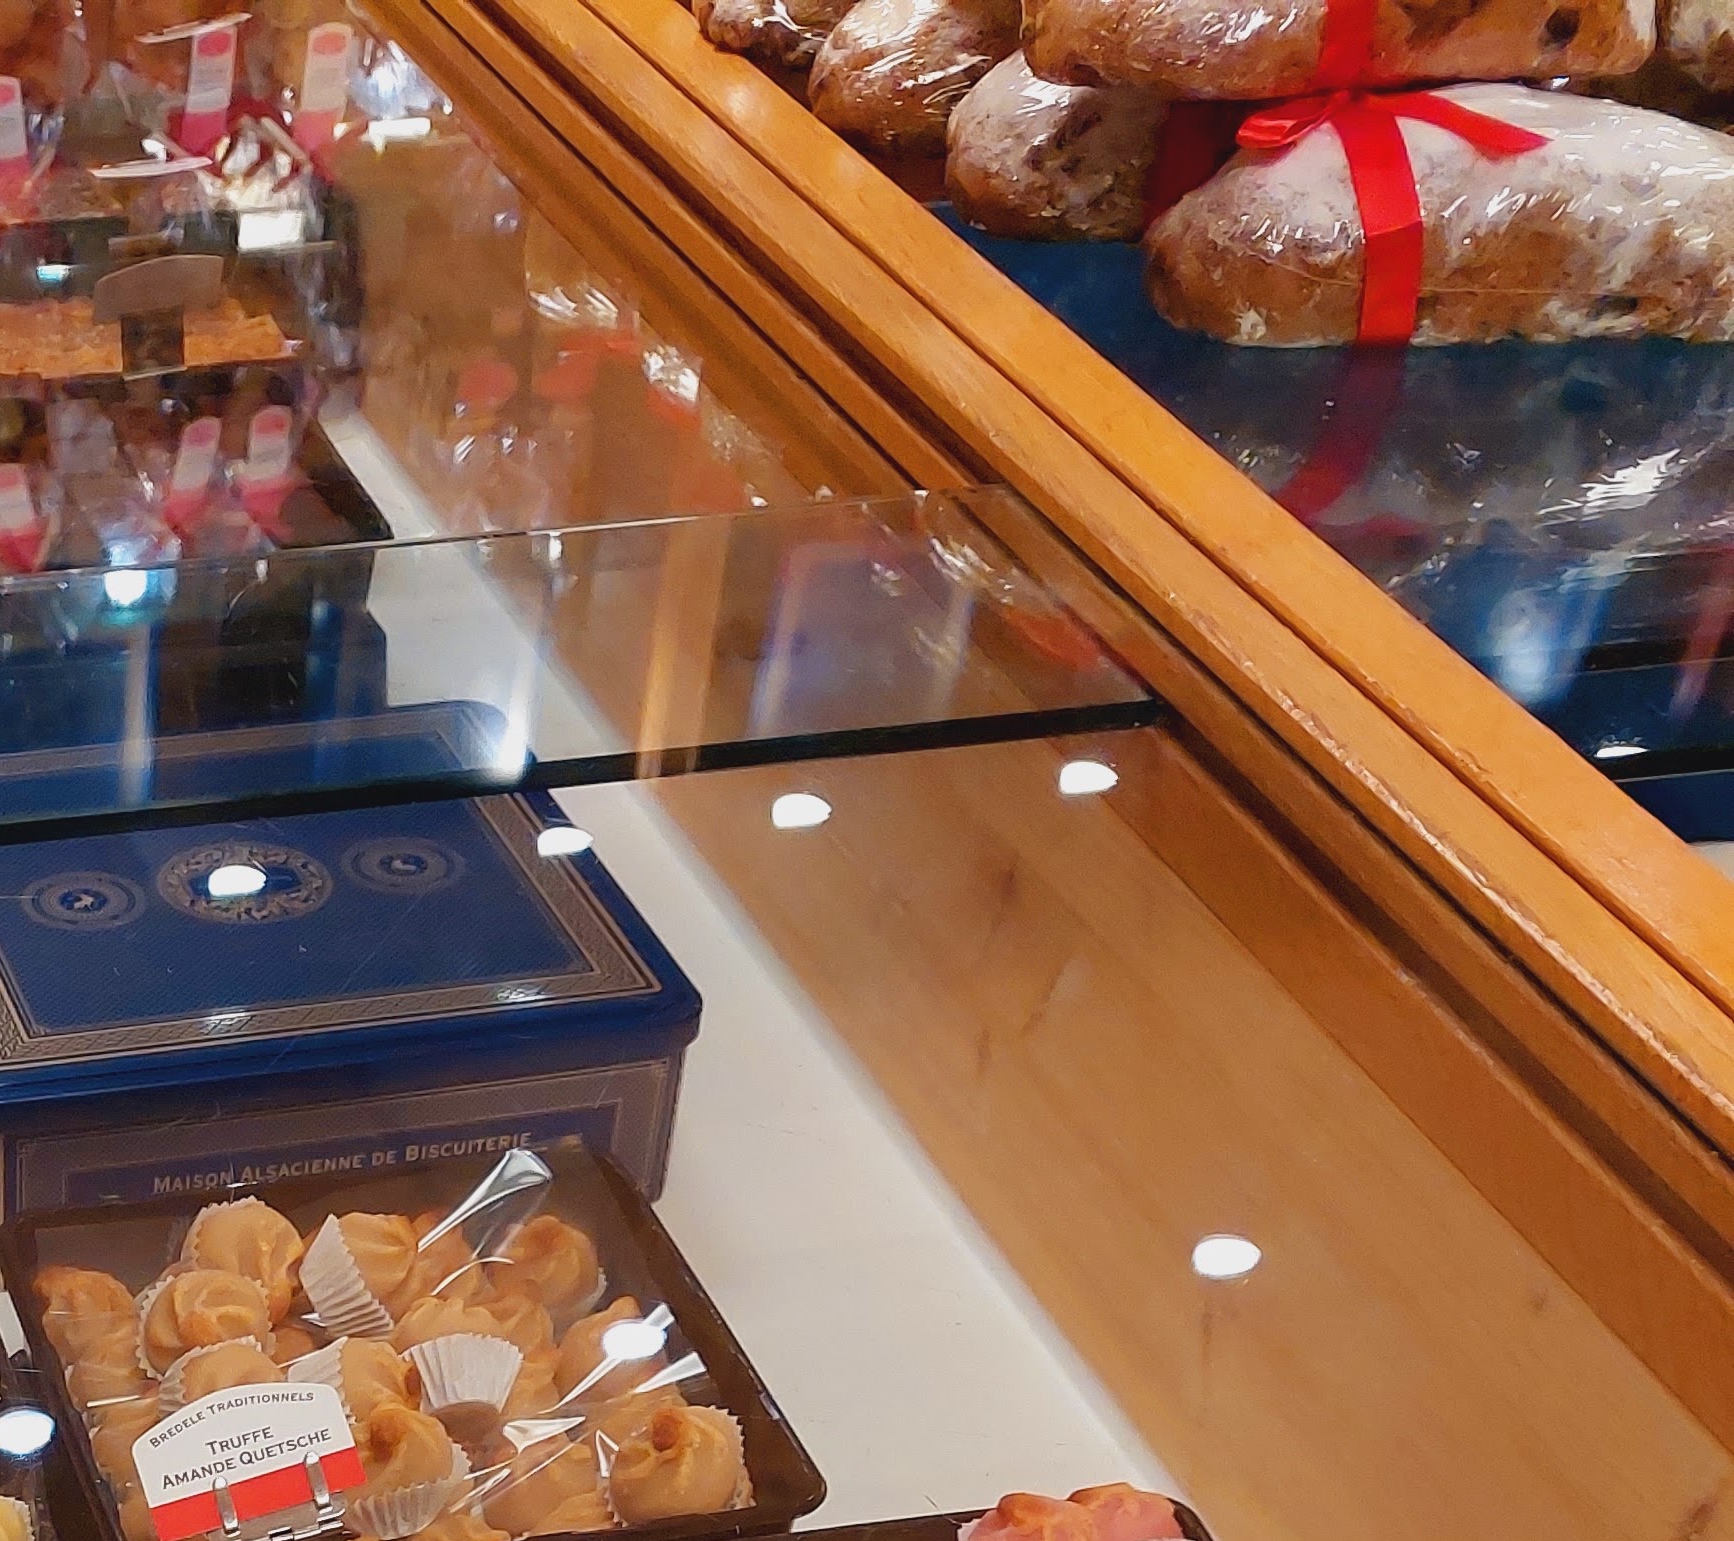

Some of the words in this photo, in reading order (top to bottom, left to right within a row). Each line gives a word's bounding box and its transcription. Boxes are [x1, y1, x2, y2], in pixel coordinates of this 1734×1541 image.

[152, 1171, 232, 1195] MAISON
[241, 1155, 363, 1184] ALSACIENNE
[371, 1149, 397, 1167] DE
[406, 1132, 532, 1163] BISCUITERIE
[149, 1410, 206, 1449] BREDELE
[206, 1391, 314, 1416] TRADITIONNELS
[205, 1426, 275, 1456] TRUFFE
[162, 1457, 237, 1490] AMANDE
[239, 1428, 332, 1466] QUETSCHE
